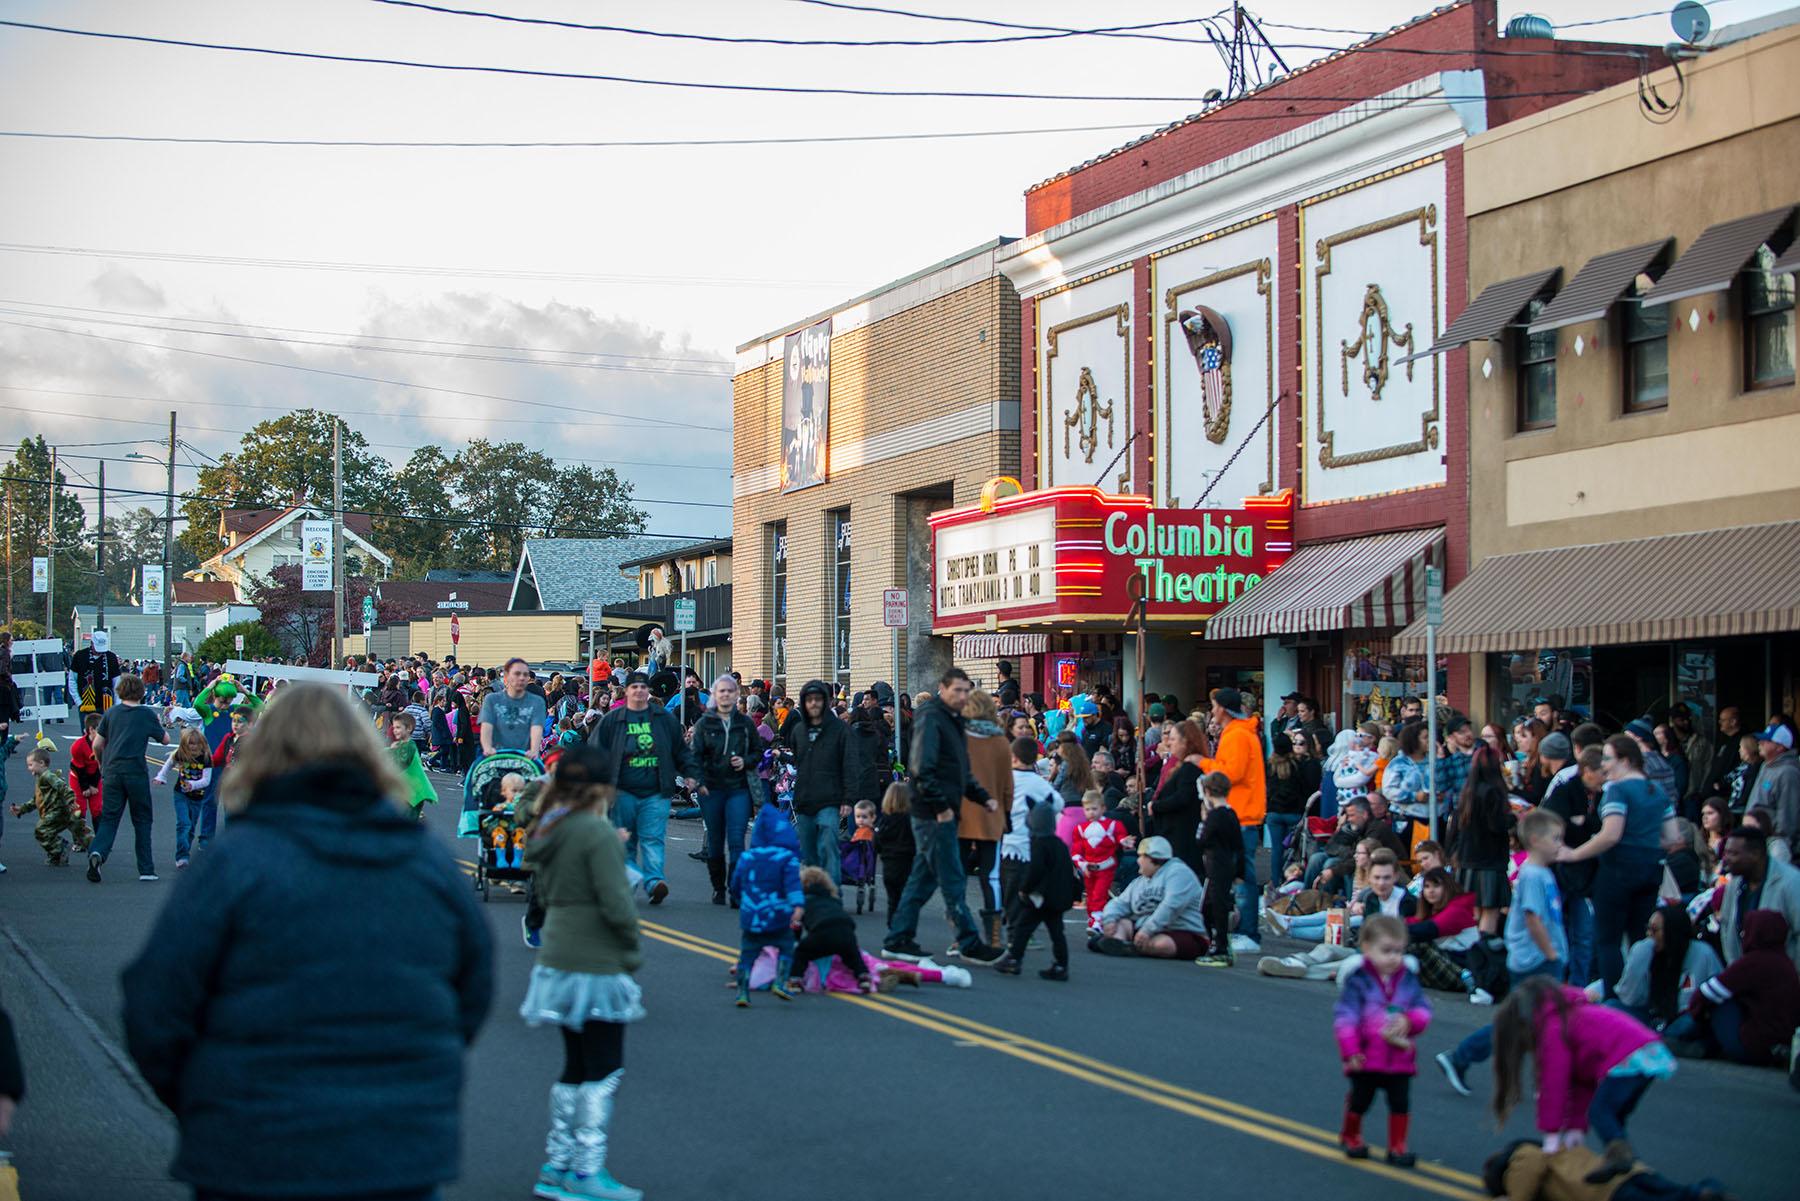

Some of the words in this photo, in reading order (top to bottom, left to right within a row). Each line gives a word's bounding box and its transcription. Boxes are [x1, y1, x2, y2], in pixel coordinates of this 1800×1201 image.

[801, 329, 829, 366] Happy
[1105, 511, 1253, 557] Columbia
[947, 555, 979, 581] CHRISTOPHER
[983, 552, 998, 576] ROBIN
[1009, 548, 1016, 571] PG
[890, 592, 900, 600] NO
[940, 585, 956, 608] HOTEL
[958, 578, 1001, 607] TRANSYLVANIA
[364, 605, 371, 616] 30
[451, 623, 459, 635] STOP
